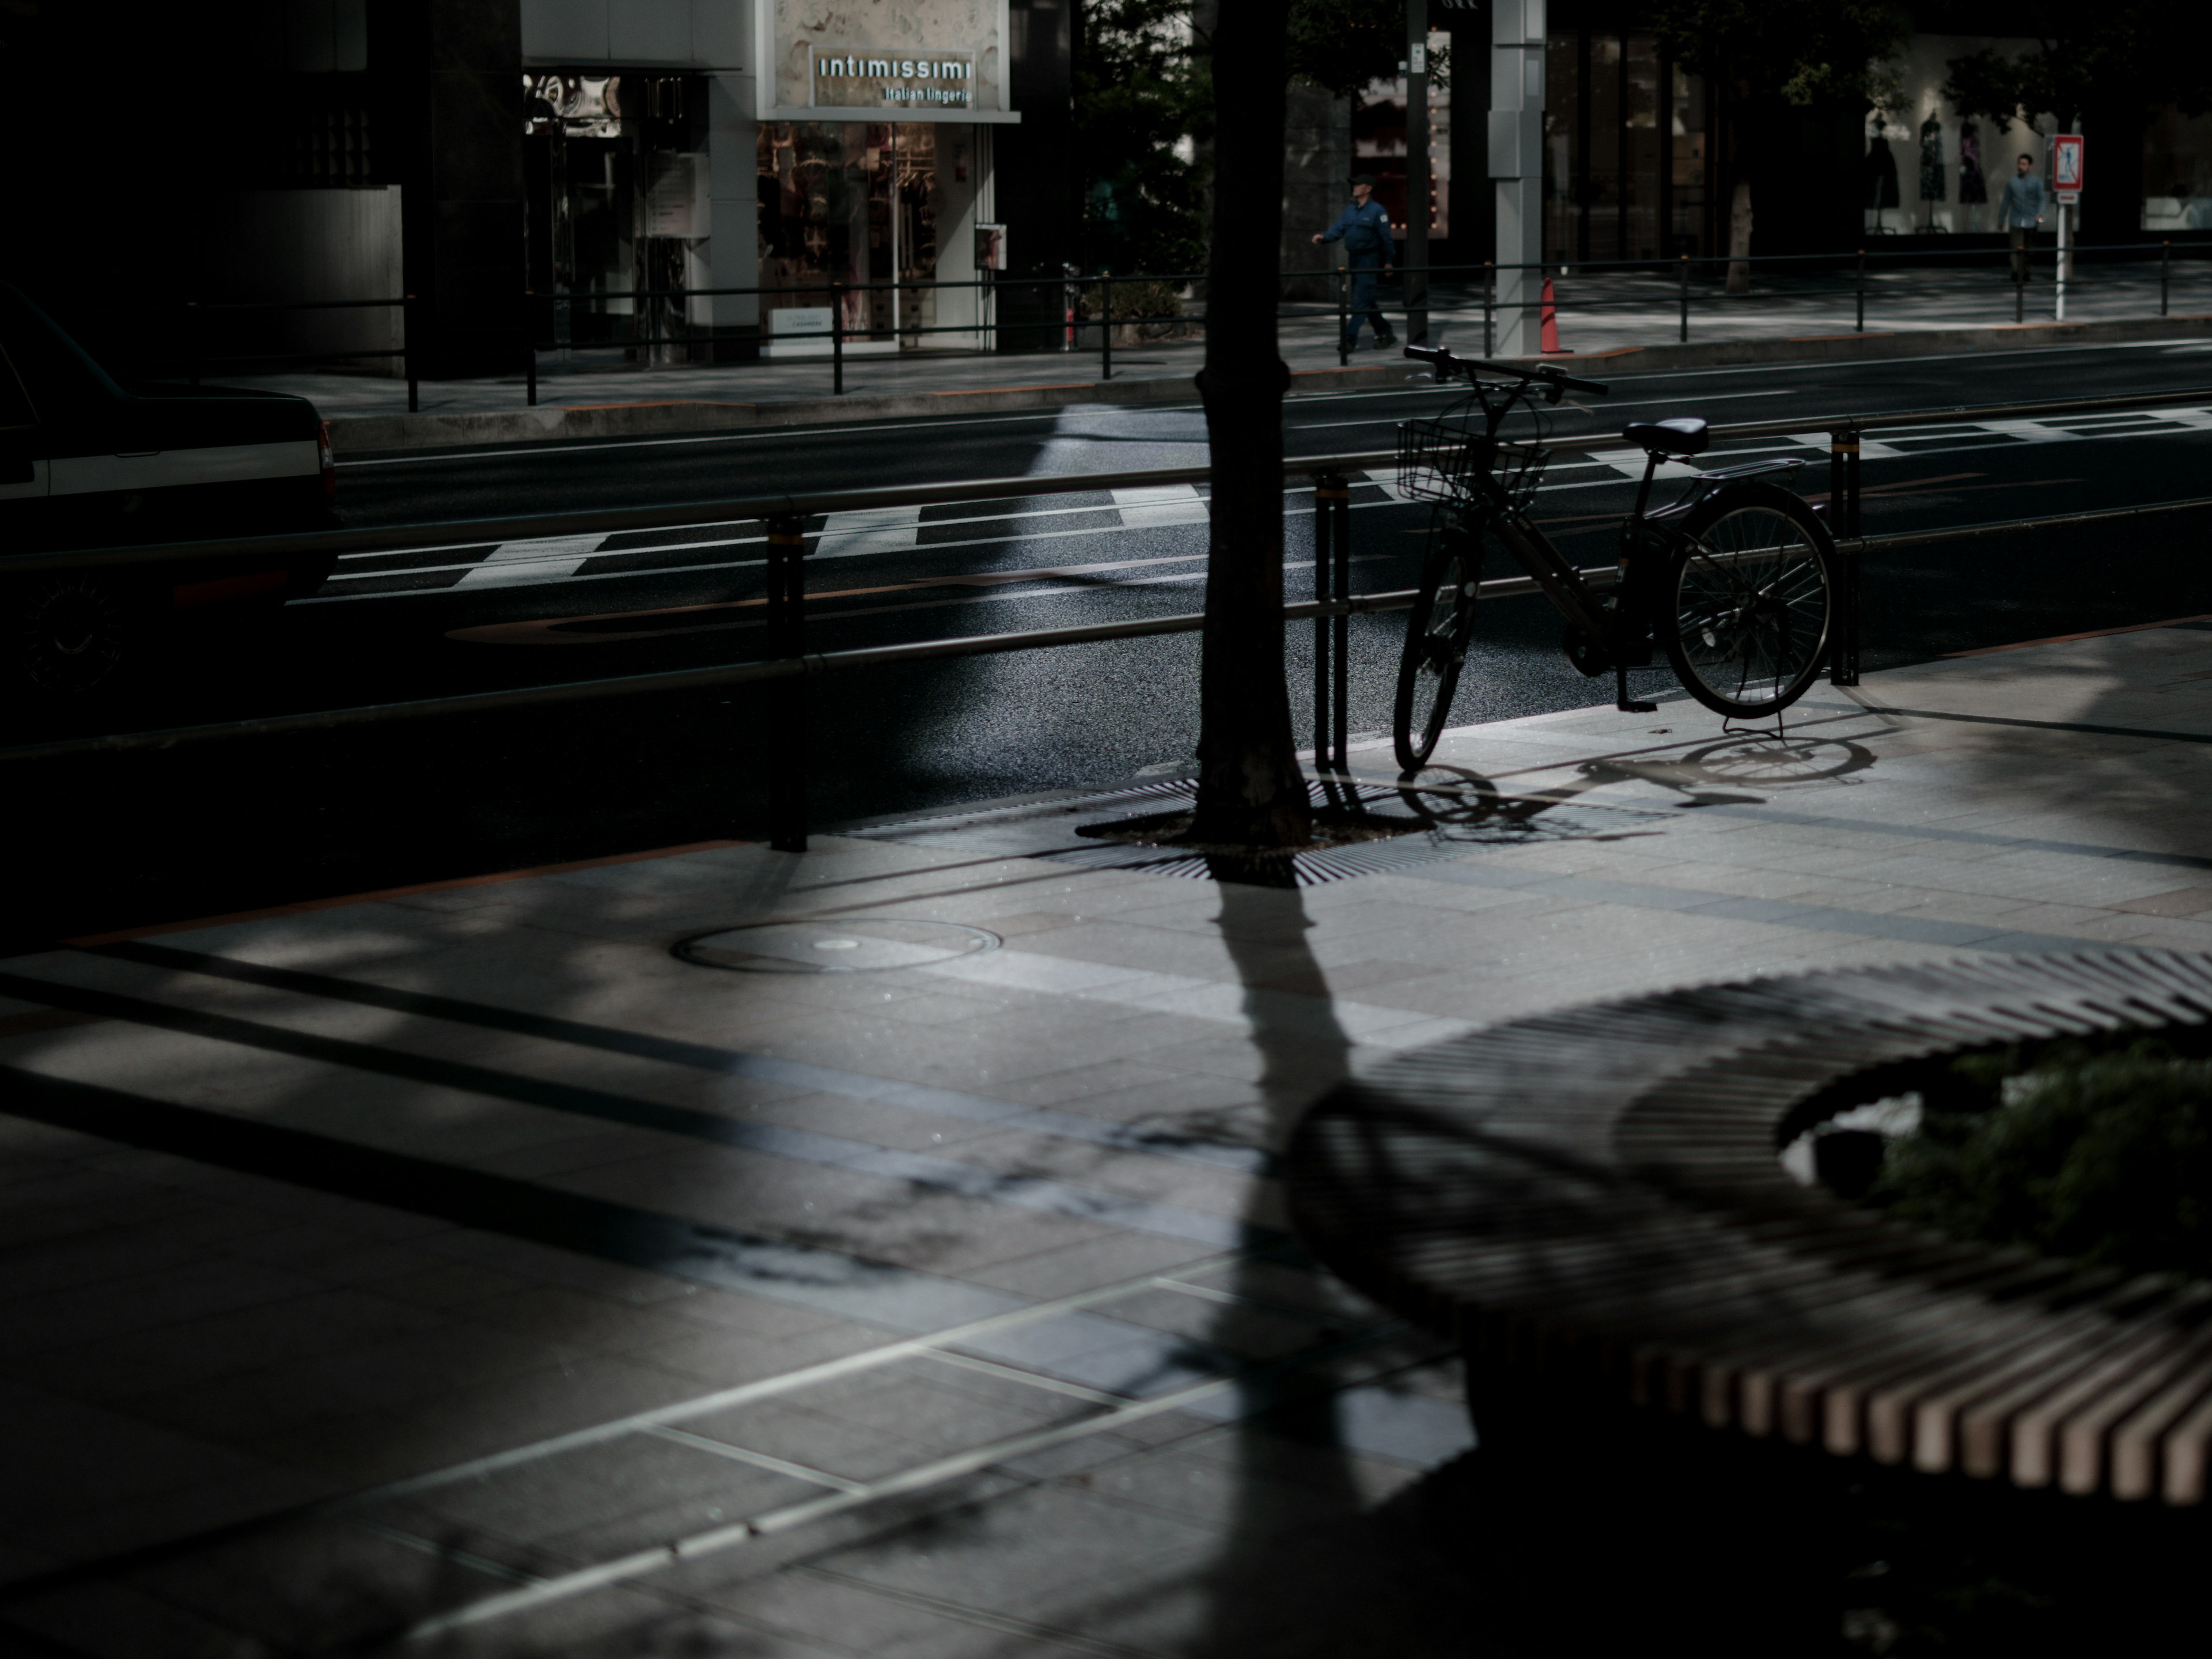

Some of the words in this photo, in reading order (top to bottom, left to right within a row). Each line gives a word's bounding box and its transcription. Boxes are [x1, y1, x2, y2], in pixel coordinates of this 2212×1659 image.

[819, 55, 971, 79] intimissimi
[884, 87, 924, 101] Italian
[926, 87, 972, 104] lingerie
